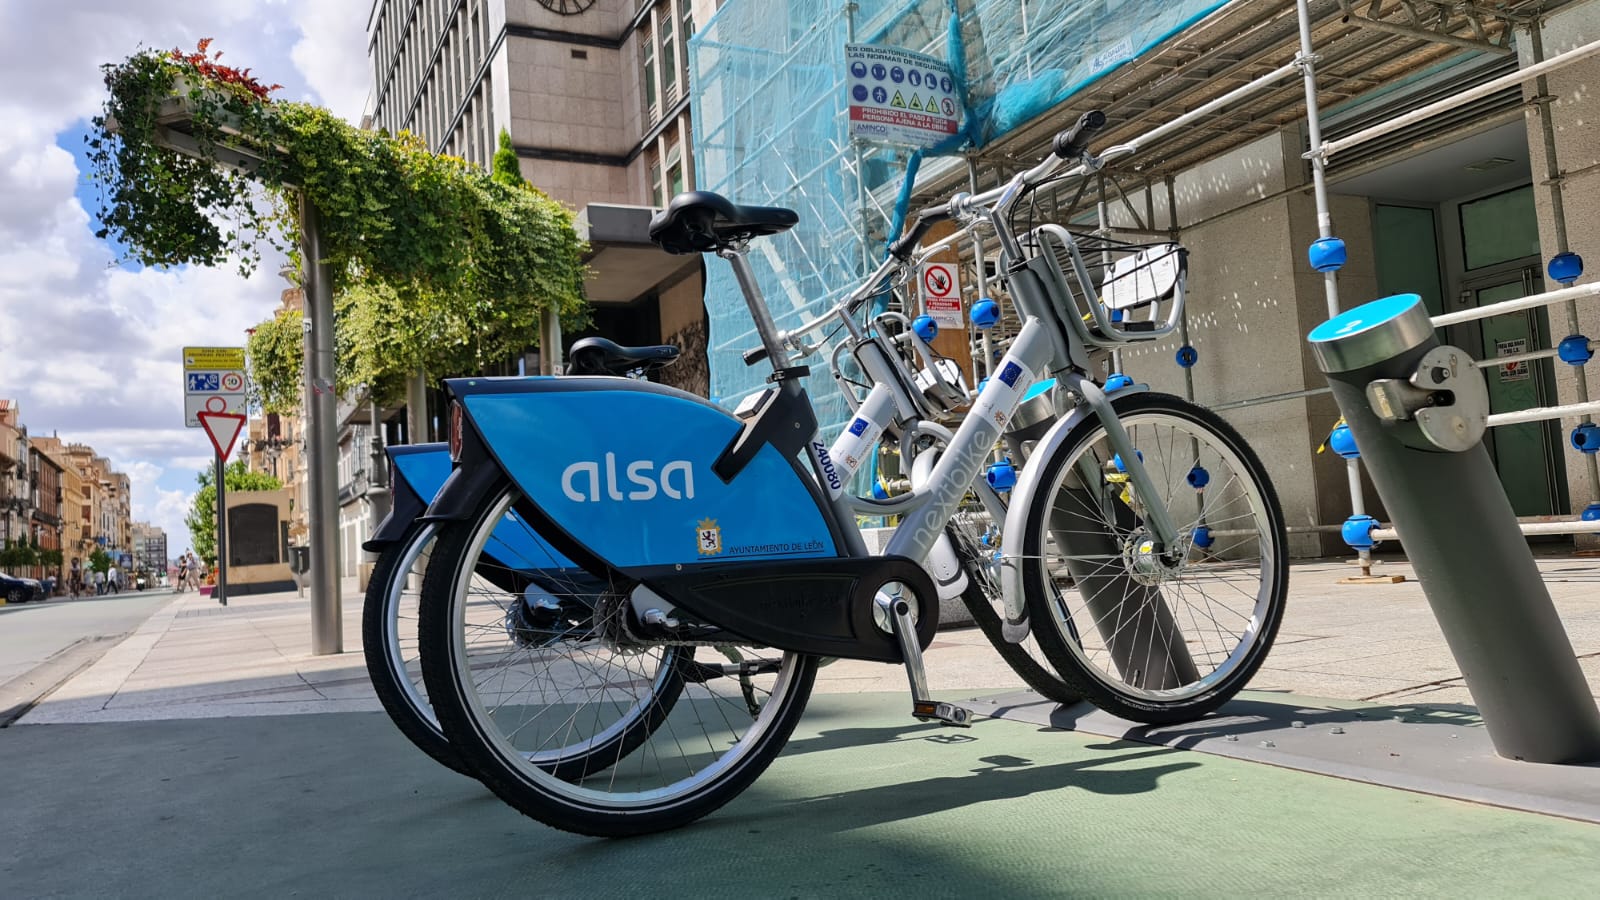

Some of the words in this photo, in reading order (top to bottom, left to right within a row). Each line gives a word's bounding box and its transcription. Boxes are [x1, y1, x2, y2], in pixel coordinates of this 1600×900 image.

[867, 54, 902, 62] NORMAS
[862, 108, 899, 118] PROHIBIDO
[908, 113, 925, 121] PASO
[862, 114, 894, 122] PERSONA
[895, 118, 916, 126] AJENA
[856, 124, 886, 132] AMINCO
[812, 440, 842, 490] 240080
[562, 452, 694, 502] alsa
[912, 430, 990, 549] nextbike
[729, 543, 790, 554] AYUNTAMIENTO
[792, 542, 802, 550] DE
